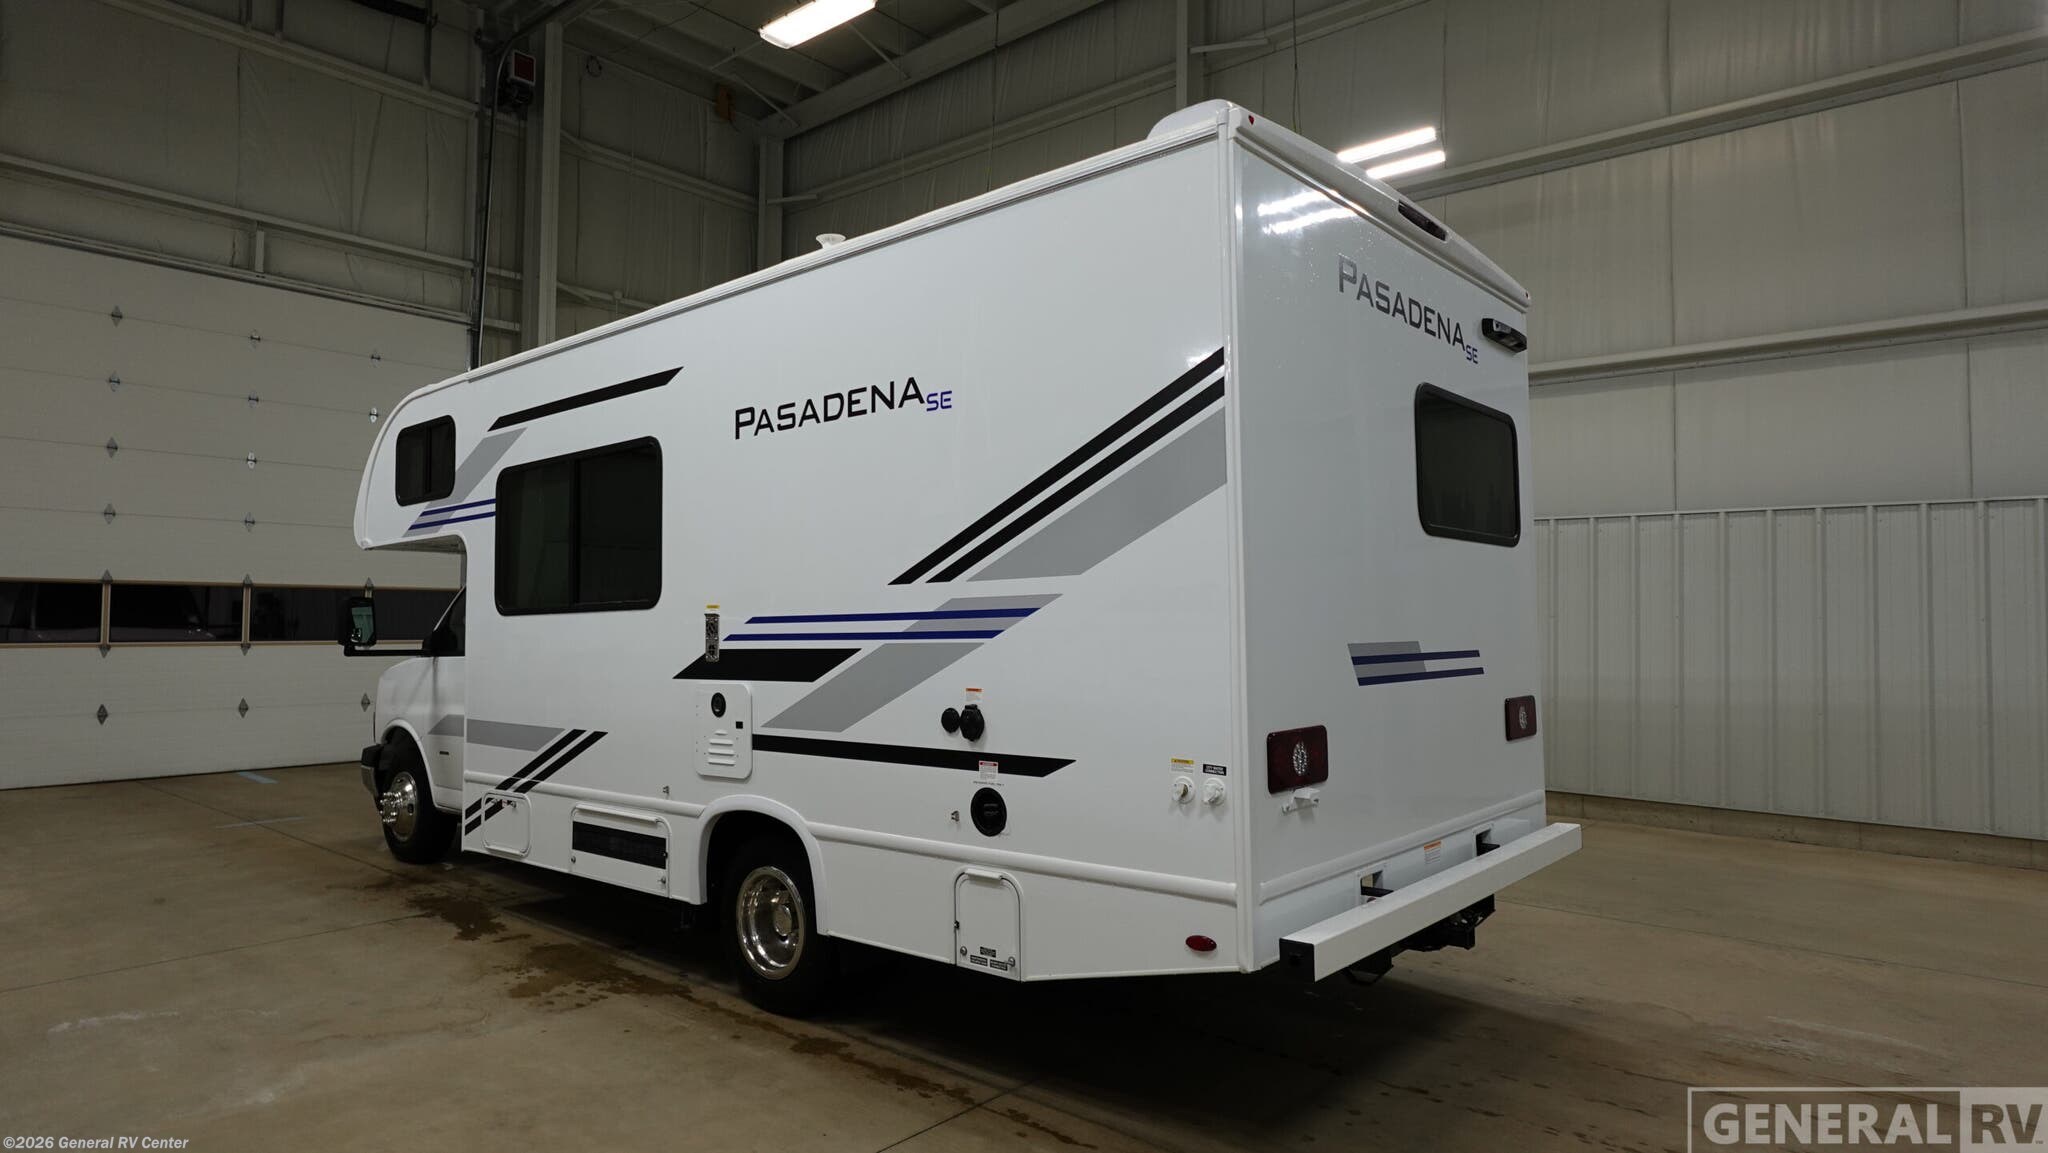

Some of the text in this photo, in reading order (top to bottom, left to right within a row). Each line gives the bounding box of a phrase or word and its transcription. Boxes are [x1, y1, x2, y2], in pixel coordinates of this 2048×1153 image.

[1338, 253, 1479, 364] PASADENA SE
[735, 376, 953, 440] PASADENA SE
